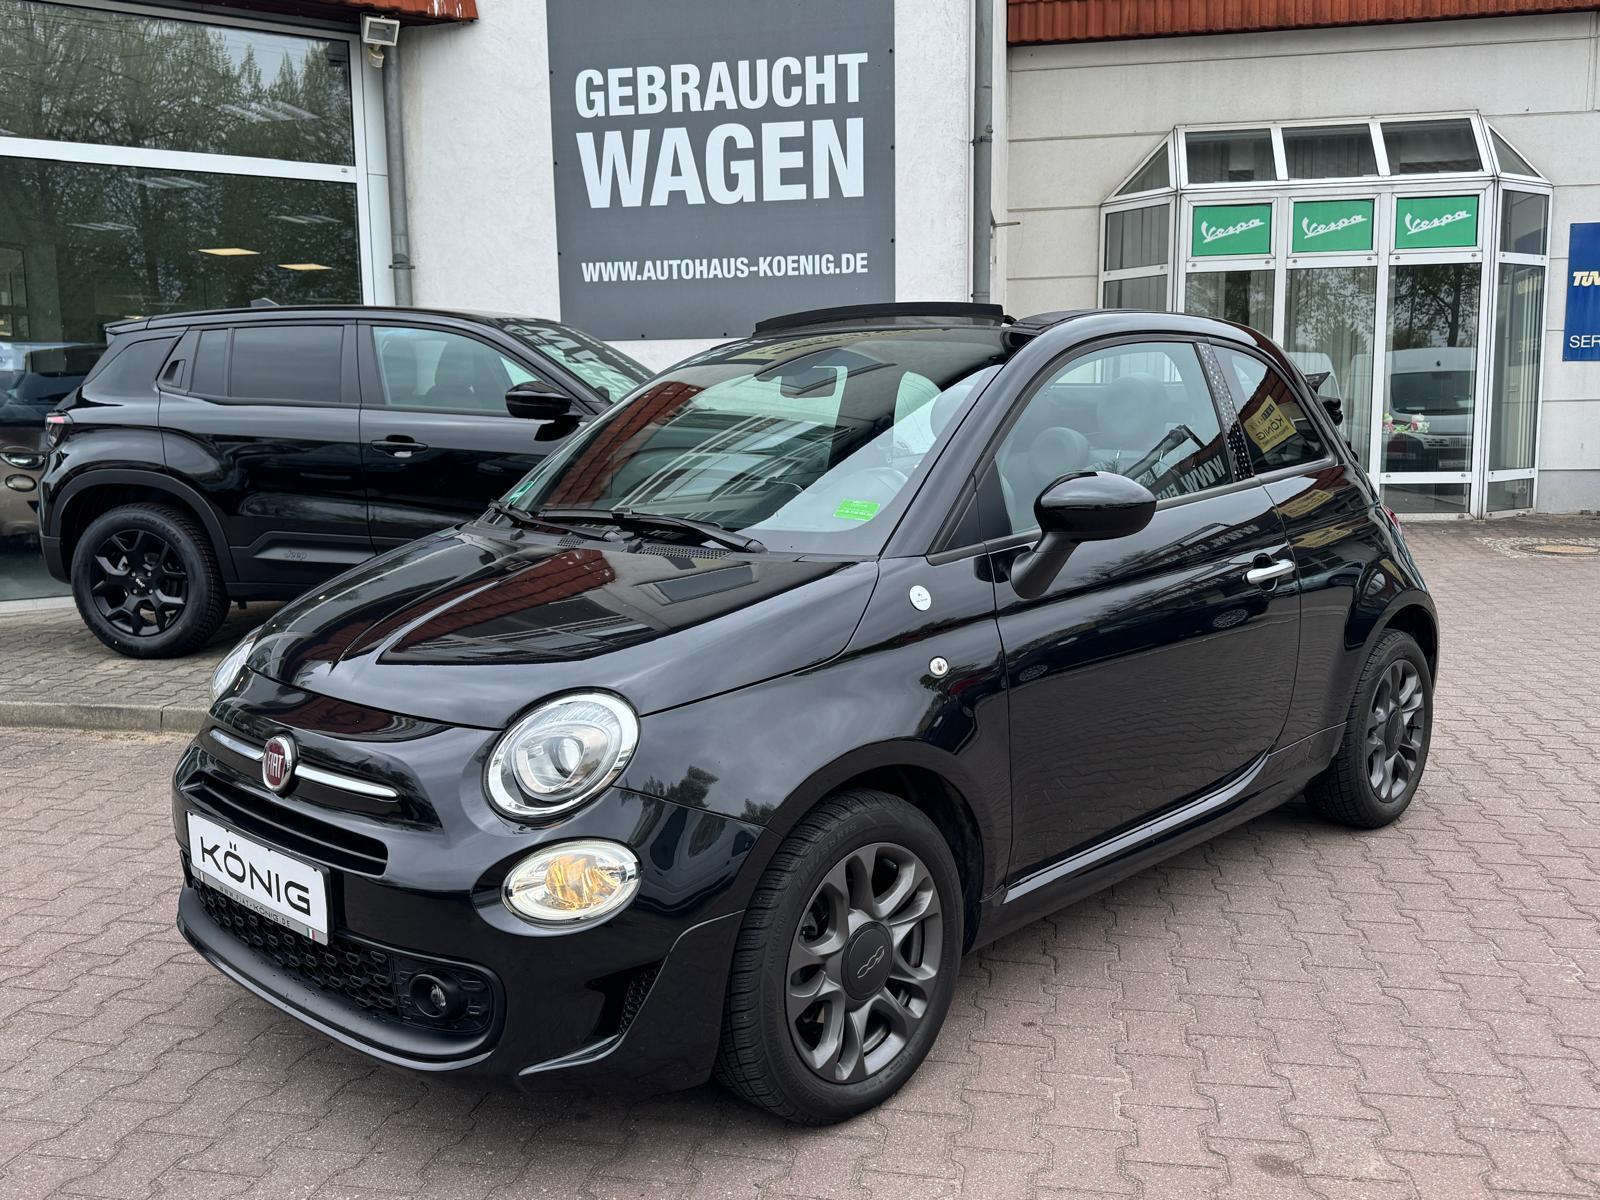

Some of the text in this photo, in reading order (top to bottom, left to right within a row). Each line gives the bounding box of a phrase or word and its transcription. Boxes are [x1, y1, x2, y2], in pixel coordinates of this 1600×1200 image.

[575, 52, 868, 118] GEBRAUCHT
[576, 117, 865, 209] WAGEN
[1201, 218, 1265, 244] Vespa
[1302, 213, 1368, 240] Vespa
[1405, 210, 1472, 236] Vespa
[581, 252, 868, 282] WWW.AUTOHAUS-KOENIG.DE
[266, 751, 285, 779] FIAT
[200, 836, 312, 917] KÖNIG
